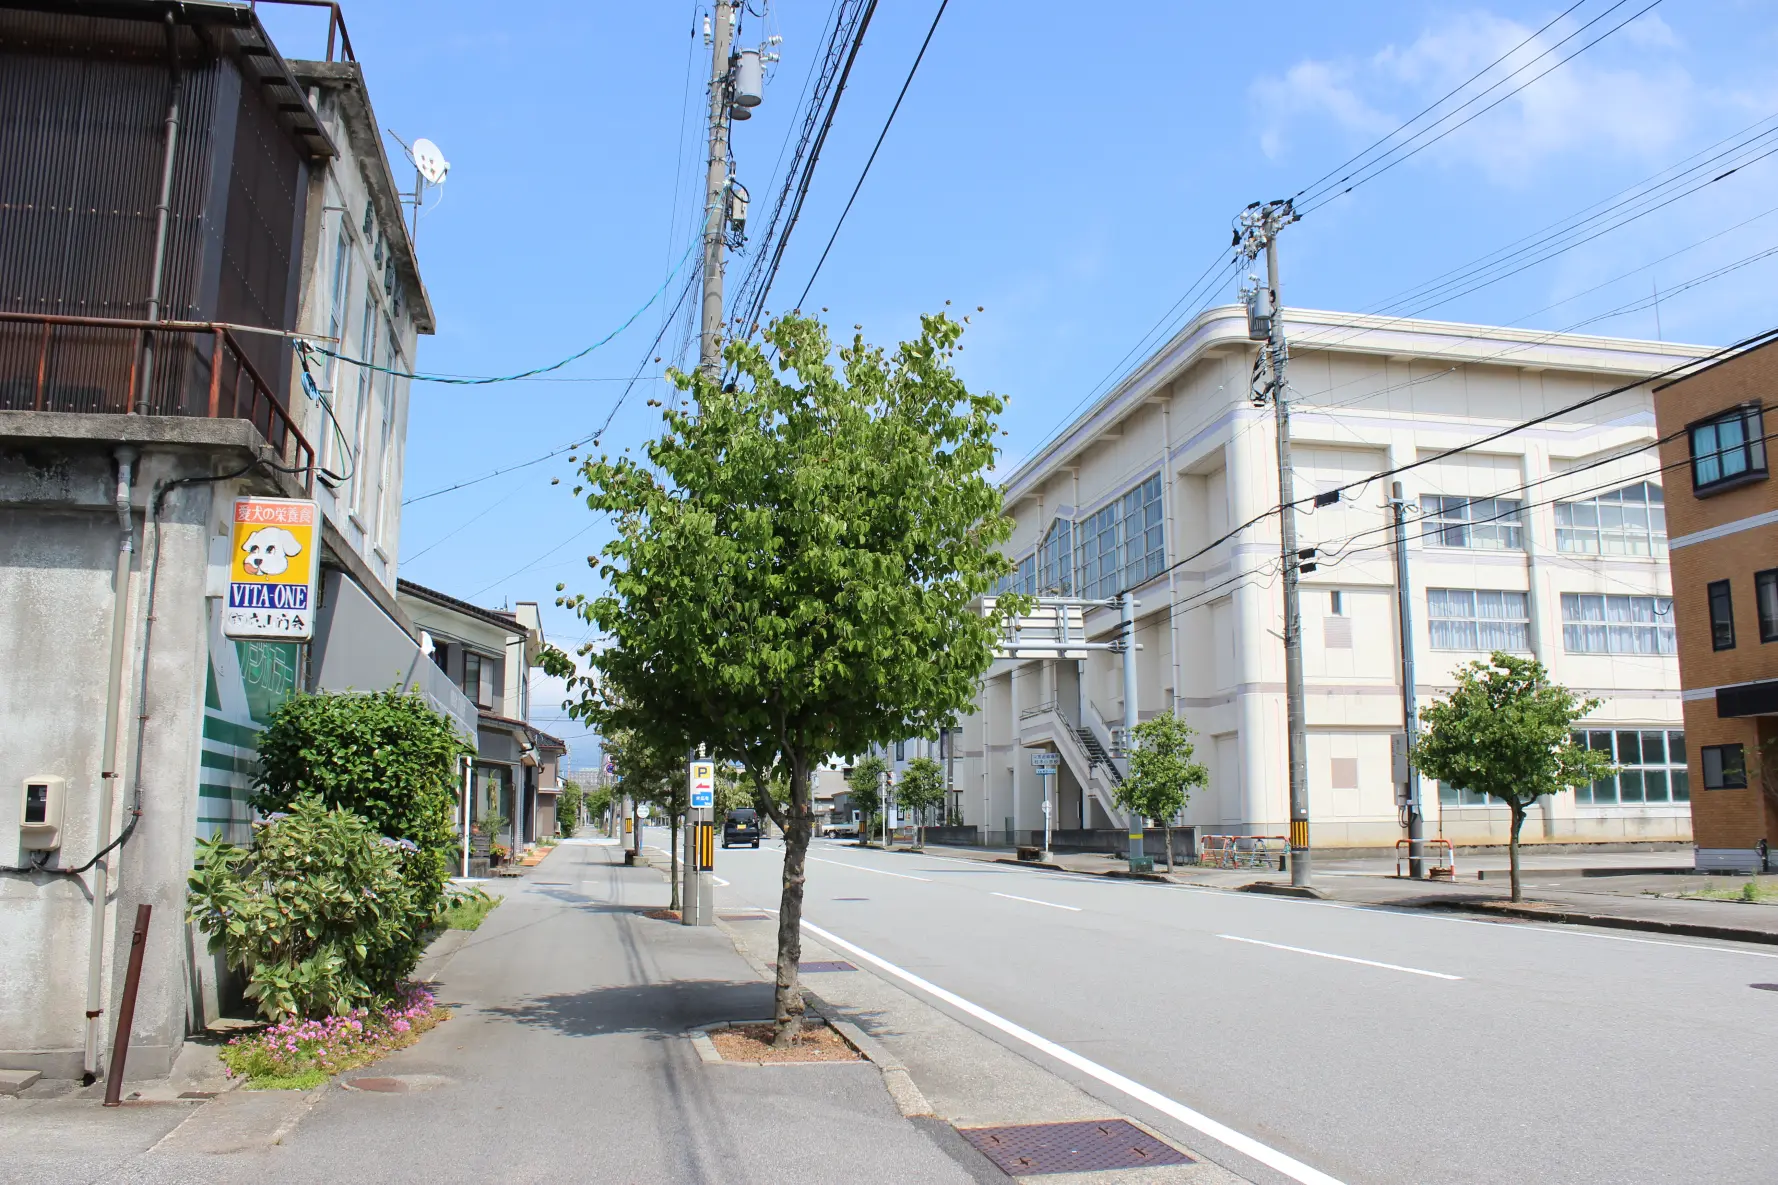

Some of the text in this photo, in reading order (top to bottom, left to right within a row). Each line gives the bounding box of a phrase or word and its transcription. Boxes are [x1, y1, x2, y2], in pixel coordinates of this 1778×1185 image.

[238, 505, 312, 524] 愛犬の栄養食
[231, 583, 307, 609] VITA-ONE
[698, 767, 707, 778] P
